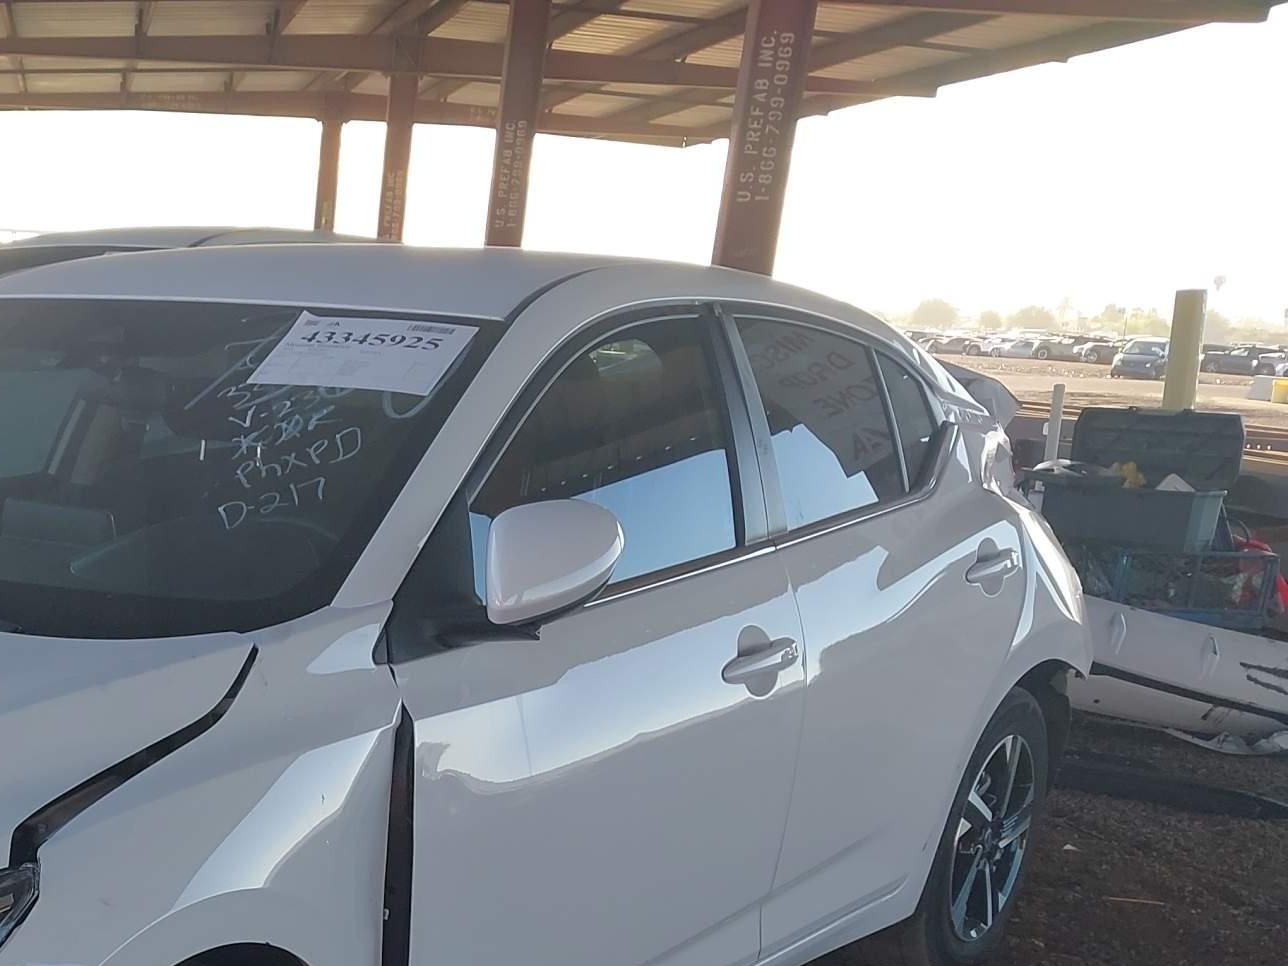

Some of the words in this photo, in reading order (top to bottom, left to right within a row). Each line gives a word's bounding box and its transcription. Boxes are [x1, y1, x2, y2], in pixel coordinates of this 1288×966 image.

[757, 30, 777, 68] INC.
[743, 78, 770, 155] PREFAB
[497, 149, 513, 199] PREFAB
[735, 166, 757, 203] U.S.
[300, 329, 445, 352] 43345925
